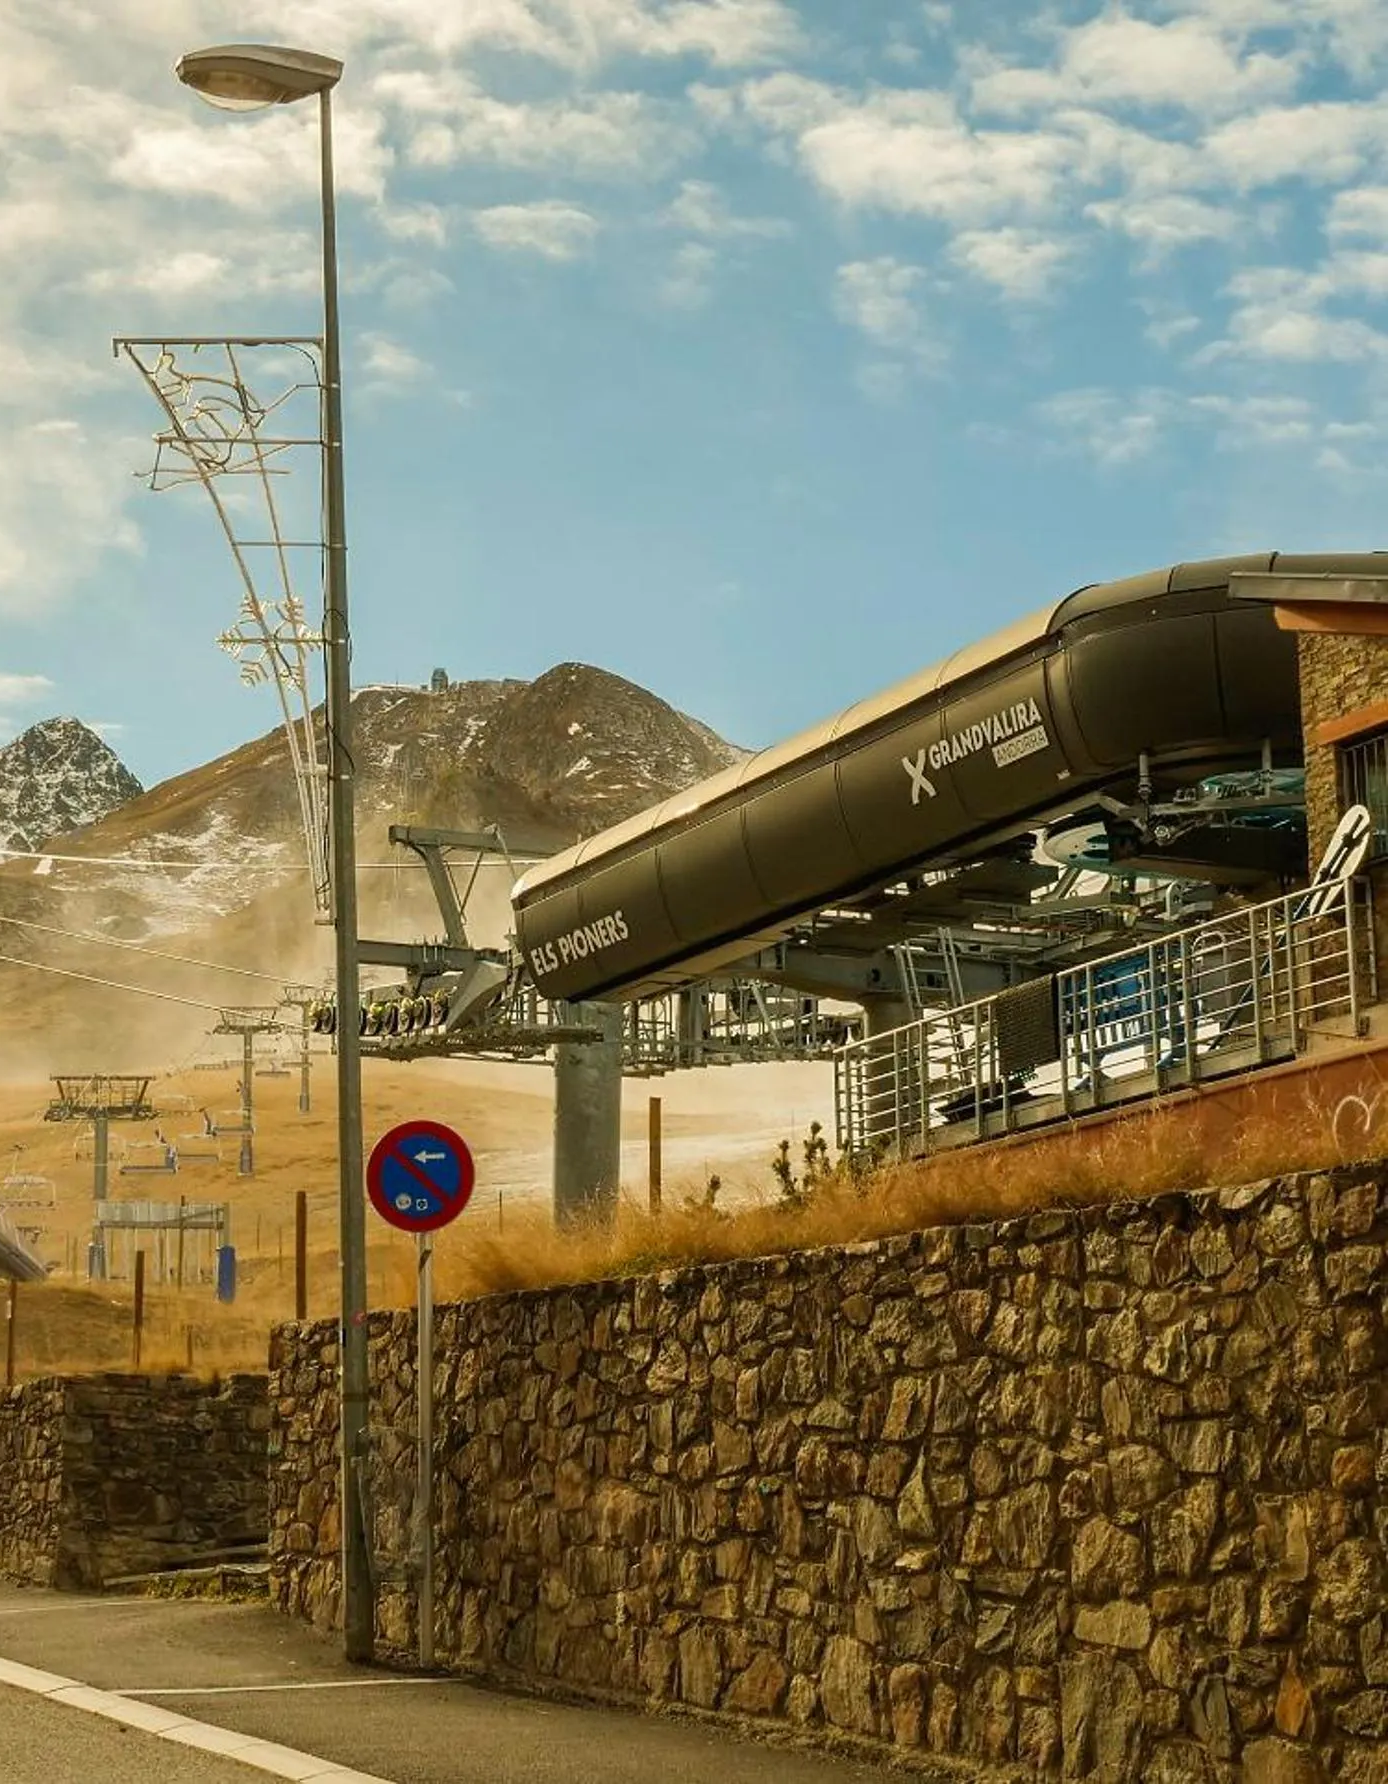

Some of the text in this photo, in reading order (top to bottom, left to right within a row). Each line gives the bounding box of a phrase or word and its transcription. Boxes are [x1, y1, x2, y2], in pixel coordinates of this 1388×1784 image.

[929, 697, 1042, 770] GRANDVALIRA
[530, 910, 629, 976] ELS PIONERS
